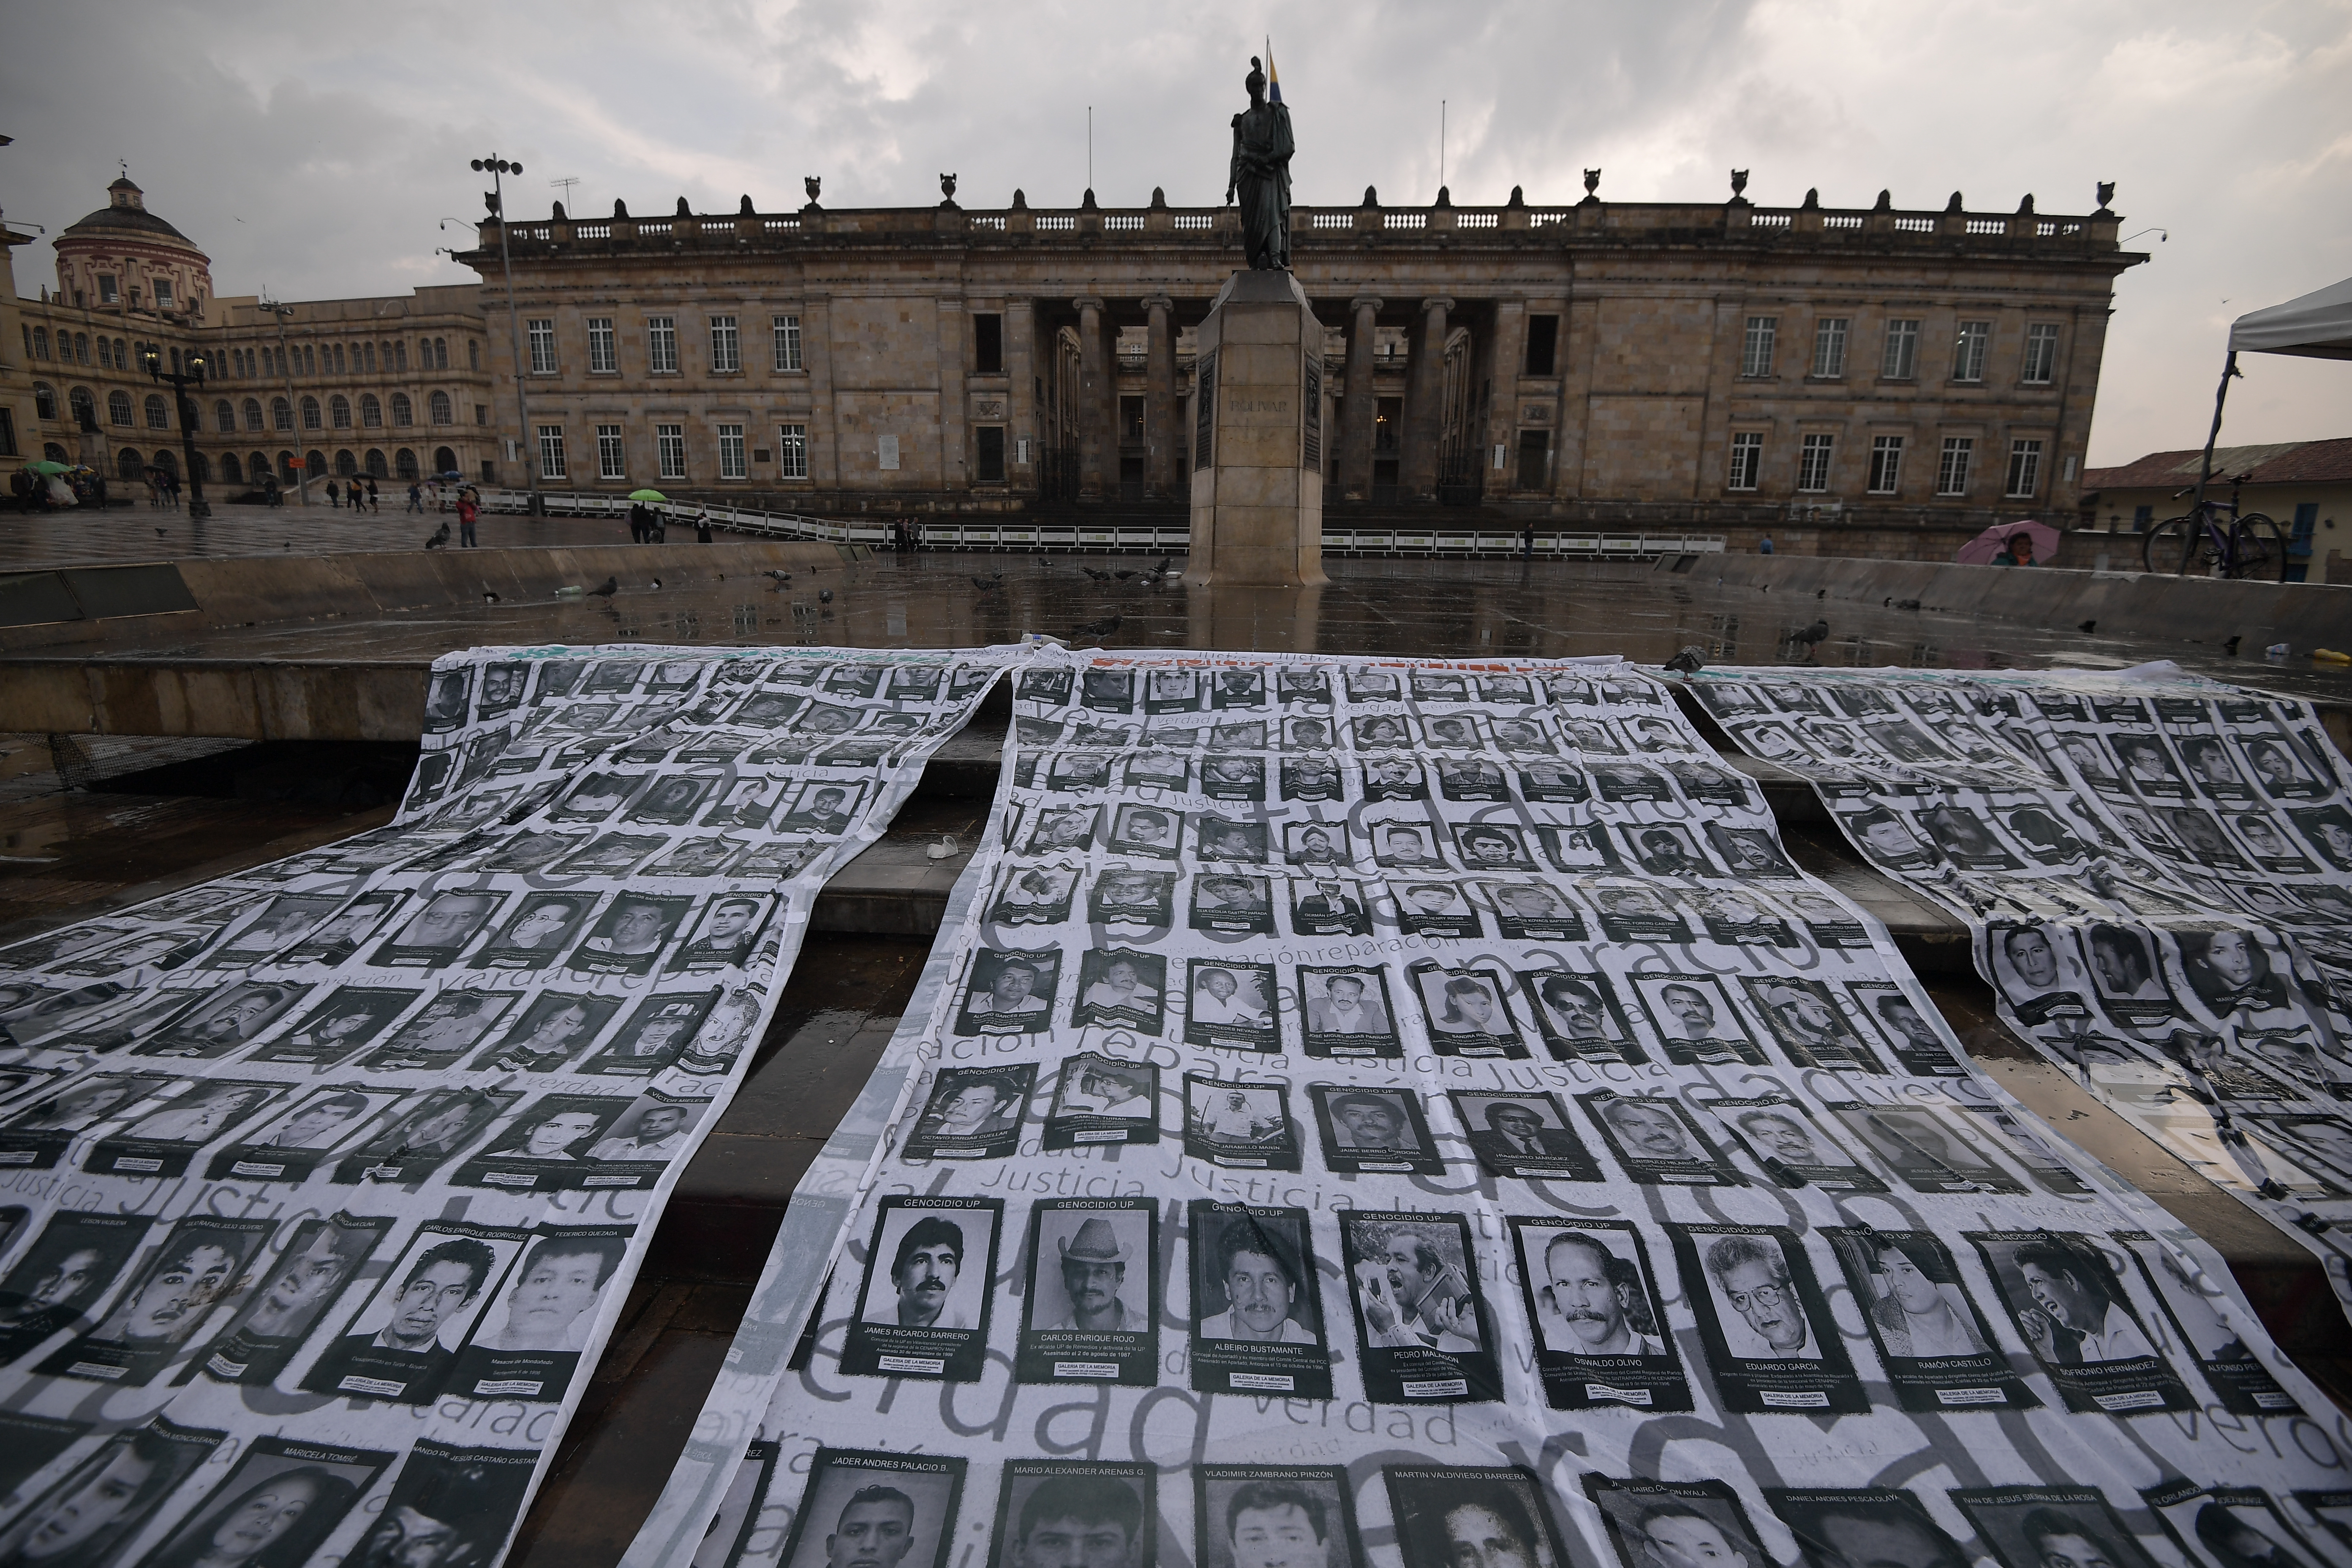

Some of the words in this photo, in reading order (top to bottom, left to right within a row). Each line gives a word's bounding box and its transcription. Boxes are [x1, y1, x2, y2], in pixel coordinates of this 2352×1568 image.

[1230, 400, 1286, 412] BOLIVAR
[993, 951, 1034, 959] GENOCIDIO
[2243, 1030, 2287, 1038] GENOCIDIO
[957, 1067, 1005, 1076] GENOCIDIO
[979, 1130, 1009, 1139] CUELLAR
[904, 1199, 963, 1208] GENOCIDIO
[966, 1200, 981, 1208] UP
[1362, 1213, 1424, 1221] GENOCIDIO
[1531, 1219, 1592, 1229] GENOCIDIO
[424, 1224, 454, 1234] CARLOS
[453, 1226, 486, 1239] ENRIQUE
[486, 1230, 528, 1241] RODRIGUEZ
[1688, 1225, 1749, 1234] GENOCIDIO
[1987, 1232, 2048, 1241] GENOCIDIO
[864, 1326, 891, 1336] JAMES
[892, 1329, 929, 1338] RICARDO
[930, 1331, 970, 1341] BARRERO
[1040, 1334, 1073, 1342] CARLOS
[1075, 1334, 1111, 1342] ENRIQUE
[1113, 1335, 1135, 1343] ROJO
[1214, 1343, 1249, 1352] ALBEIRO
[1250, 1345, 1303, 1355] BUSTAMANTE
[1394, 1350, 1420, 1359] PEDRO
[1574, 1357, 1614, 1367] OSWALDO
[1617, 1358, 1642, 1367] OLIVO
[1745, 1362, 1786, 1371] EDUARDO
[1788, 1361, 1821, 1371] GARCÍA
[1918, 1360, 1950, 1369] RAMÓN
[1950, 1357, 1991, 1368] CASTILLO
[2059, 1366, 2103, 1377] SOFRONIO
[2104, 1360, 2157, 1374] HERNÁNDEZ
[2207, 1363, 2243, 1373] ALFONSO
[284, 1447, 327, 1460] MARICELA
[440, 1449, 451, 1458] DE
[474, 1454, 508, 1464] CASTAÑO
[832, 1456, 861, 1466] JADER
[862, 1459, 899, 1469] ANDRES
[900, 1462, 938, 1472] PALACIO
[940, 1464, 948, 1472] B.
[1044, 1467, 1097, 1475] ALEXANDER
[1300, 1470, 1334, 1478] PINZÓN
[1995, 1494, 2022, 1504] JESUS
[2022, 1493, 2052, 1501] SIERRA
[2161, 1486, 2201, 1503] ORLANDO
